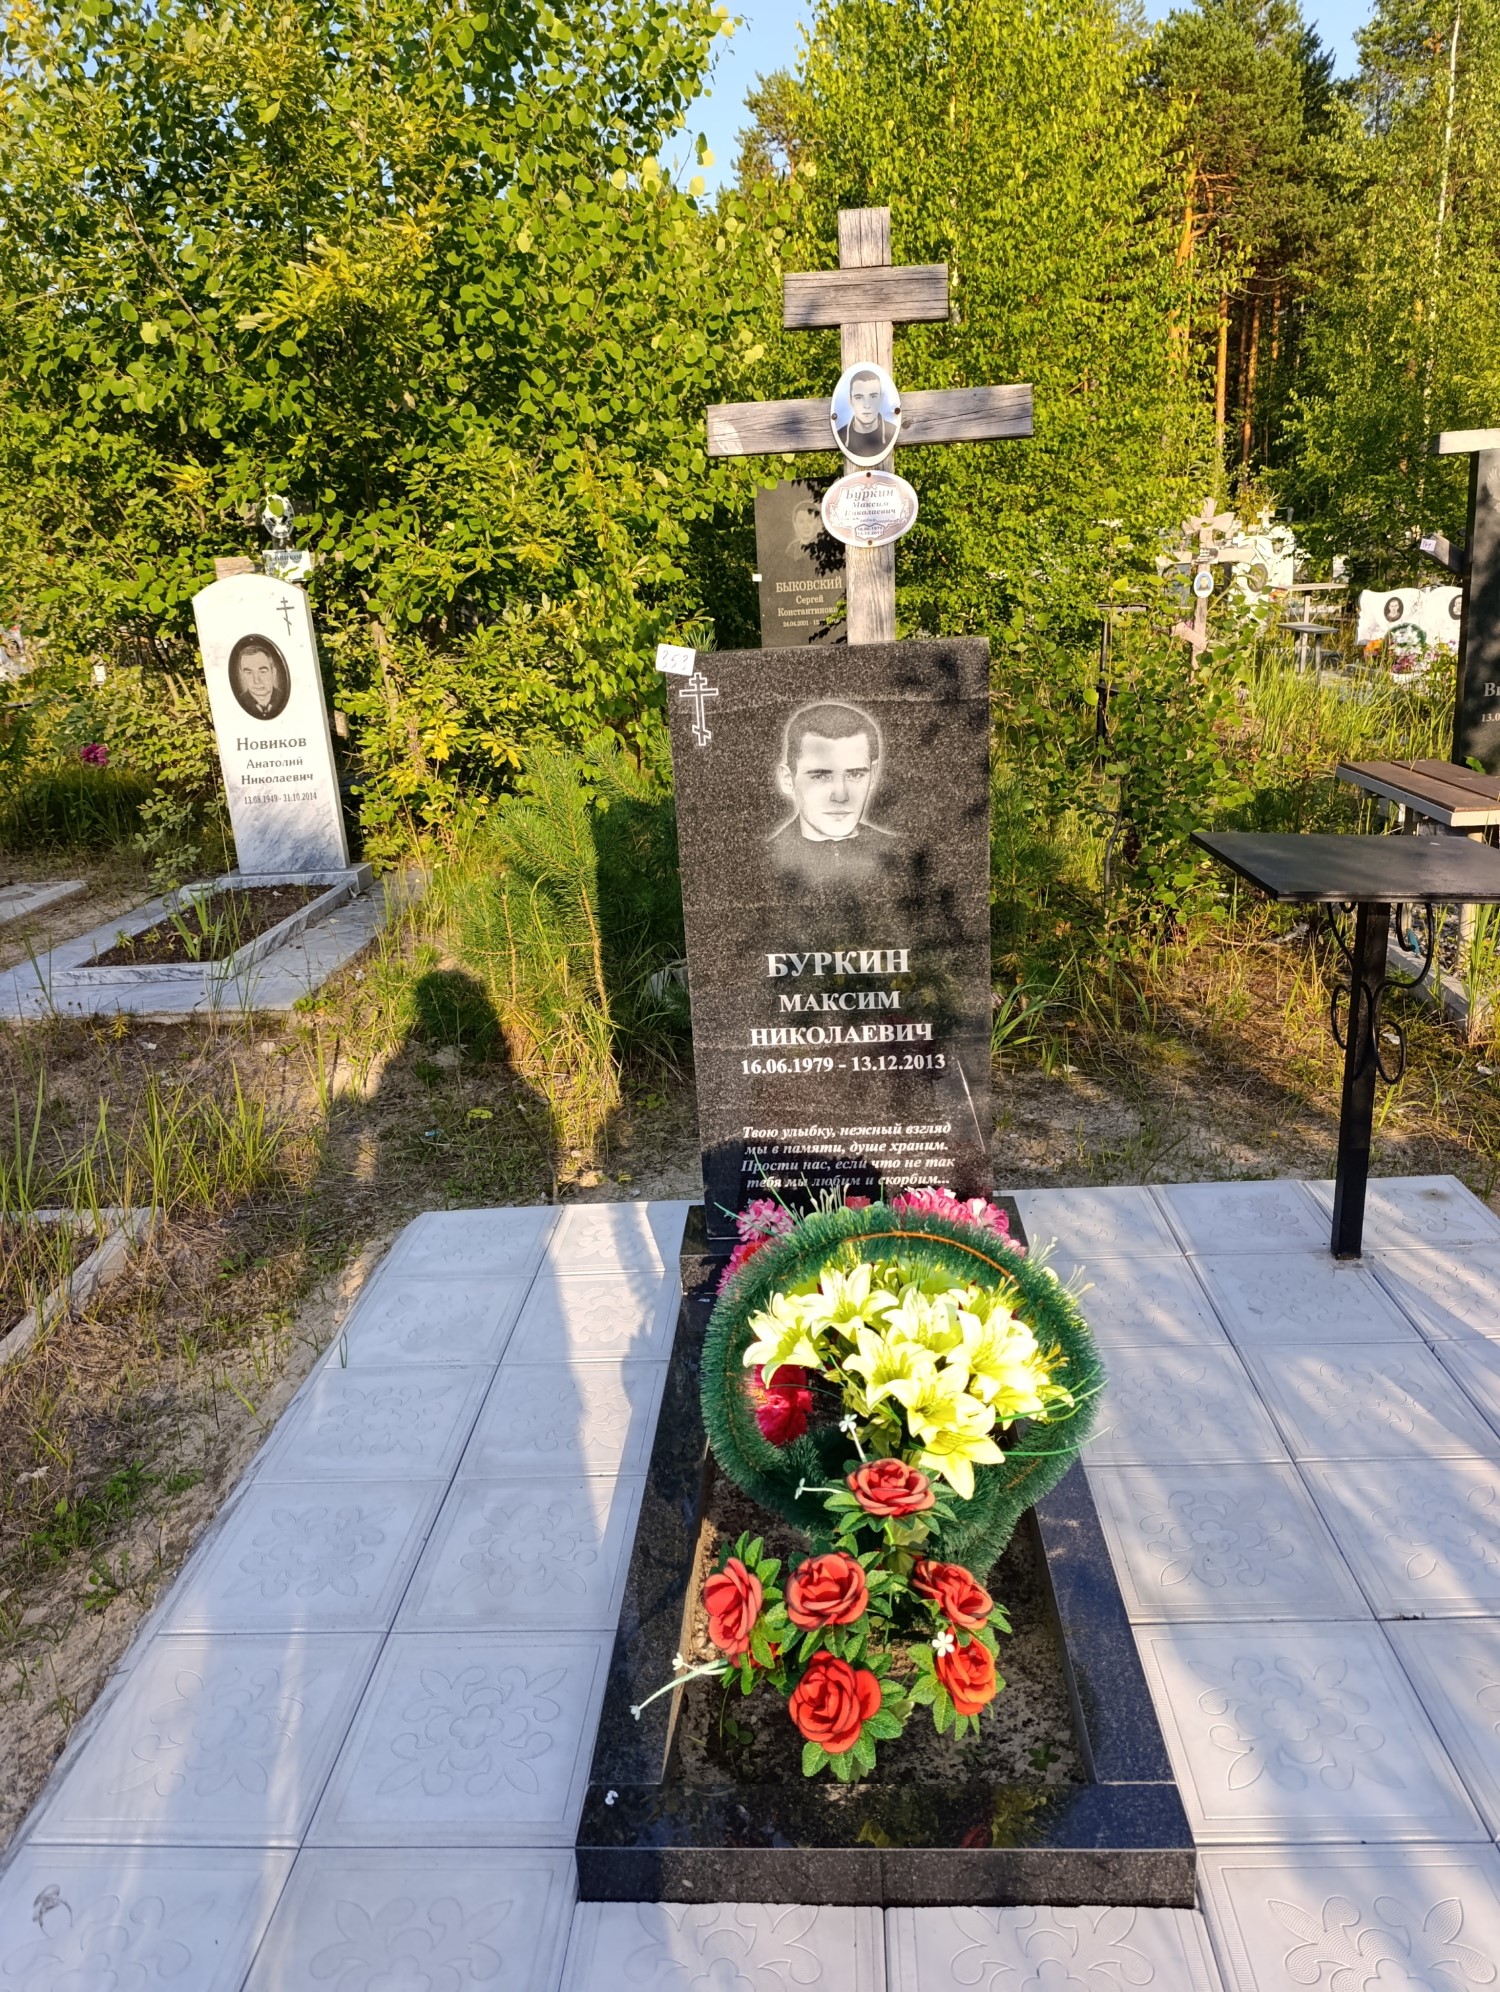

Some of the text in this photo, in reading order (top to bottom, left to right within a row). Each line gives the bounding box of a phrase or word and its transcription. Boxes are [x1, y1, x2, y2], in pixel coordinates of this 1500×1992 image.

[846, 489, 894, 501] Буркин
[776, 576, 843, 592] БЫКОВСКИЙ
[796, 594, 824, 605] Сергей
[236, 737, 307, 751] Новиков
[246, 757, 303, 769] Анатолий
[241, 773, 314, 785] Николаевич
[765, 949, 911, 977] БУРКИН
[779, 991, 901, 1012] МАКСИМ
[750, 1023, 934, 1046] НИКОЛАЕВИЧ
[741, 1057, 834, 1074] 16.06.1979
[852, 1054, 946, 1072] 13.12.2013
[742, 1122, 951, 1141] Твою улыбку, нежный взгляд
[745, 1141, 949, 1155] мы в памяти, душе храним.
[740, 1157, 956, 1174] Прости нас, если что не так
[747, 1173, 950, 1188] тебя мы любим и скорбим...
